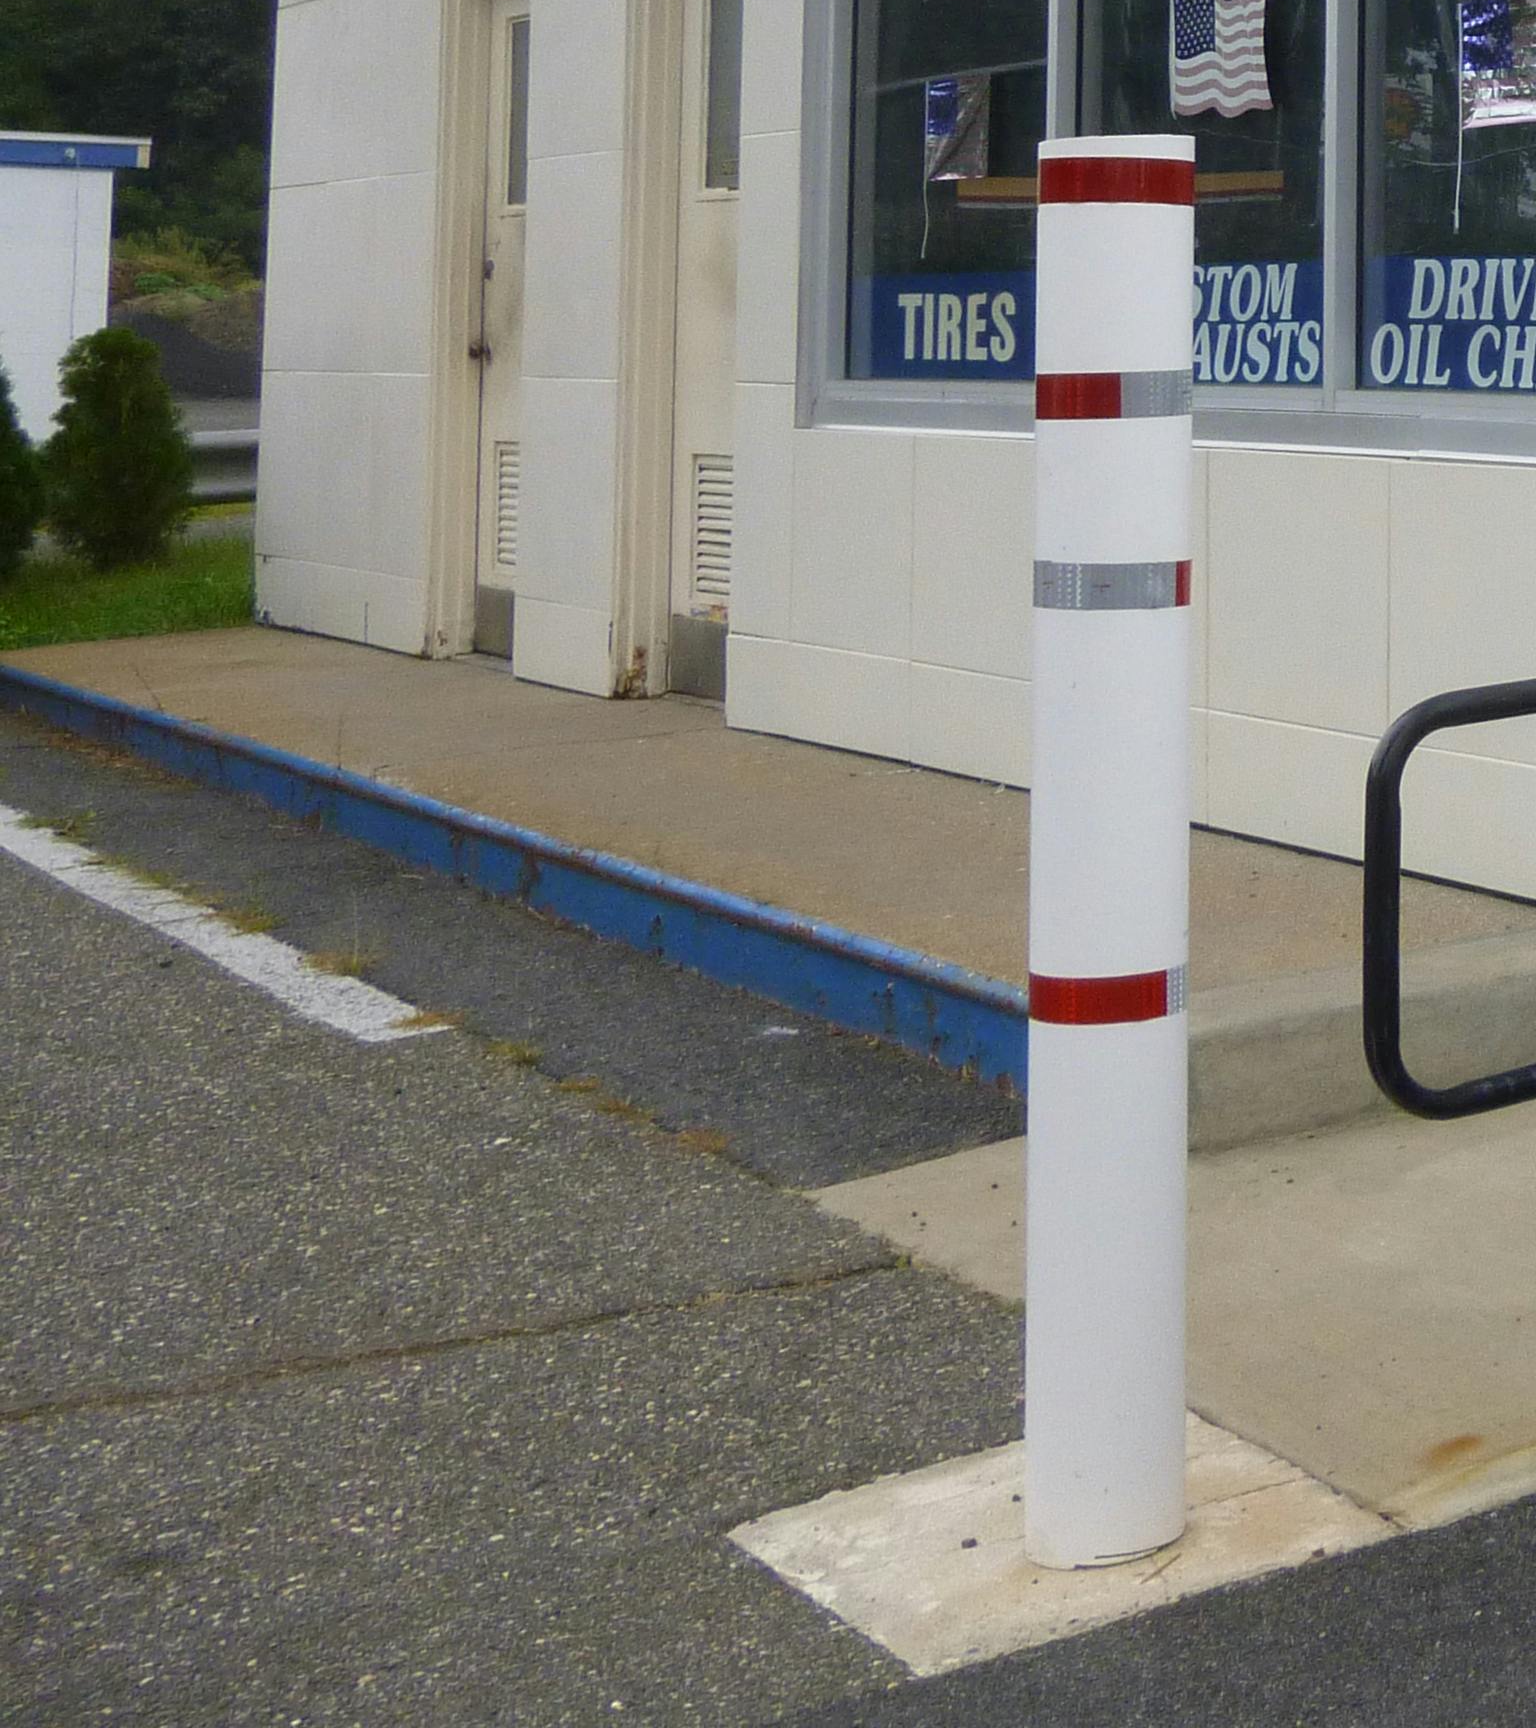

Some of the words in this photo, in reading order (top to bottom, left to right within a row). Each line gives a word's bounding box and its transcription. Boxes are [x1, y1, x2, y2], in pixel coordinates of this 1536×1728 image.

[898, 290, 1017, 363] TIRES
[1193, 319, 1321, 383] AUSTS
[1370, 323, 1451, 386] OIL
